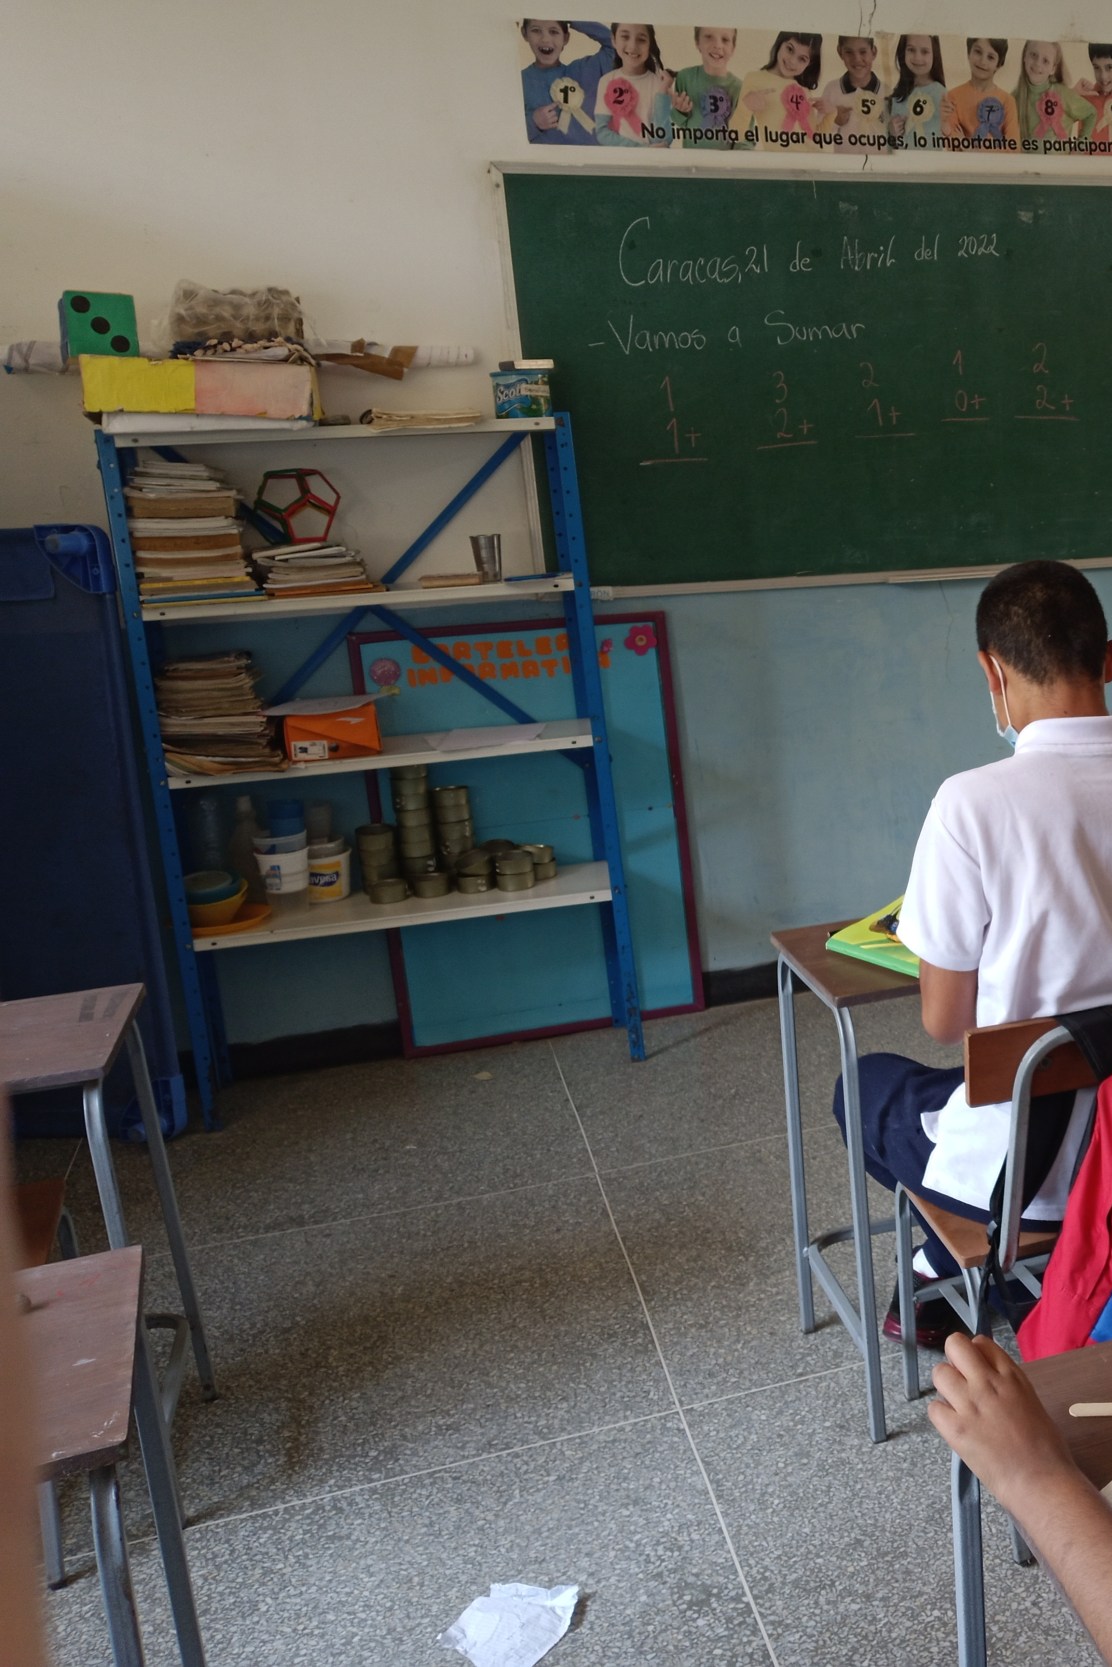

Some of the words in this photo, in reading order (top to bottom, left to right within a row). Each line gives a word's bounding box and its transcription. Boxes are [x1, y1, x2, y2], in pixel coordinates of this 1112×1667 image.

[641, 123, 666, 139] No
[672, 123, 739, 147] importa
[744, 128, 759, 143] el
[764, 126, 807, 148] lugar
[812, 130, 843, 150] que
[848, 132, 909, 151] ocupes,
[913, 131, 928, 149] lo
[932, 131, 1018, 153] importante
[1021, 138, 1039, 151] es
[789, 240, 813, 272] de
[914, 233, 940, 261] del
[957, 232, 1000, 258] 2022
[727, 325, 742, 347] a
[765, 309, 865, 346] Sumar
[953, 349, 964, 375] 1
[1032, 342, 1049, 373] 2
[772, 370, 788, 404] 3
[859, 361, 880, 388] 2
[659, 375, 675, 412] 1
